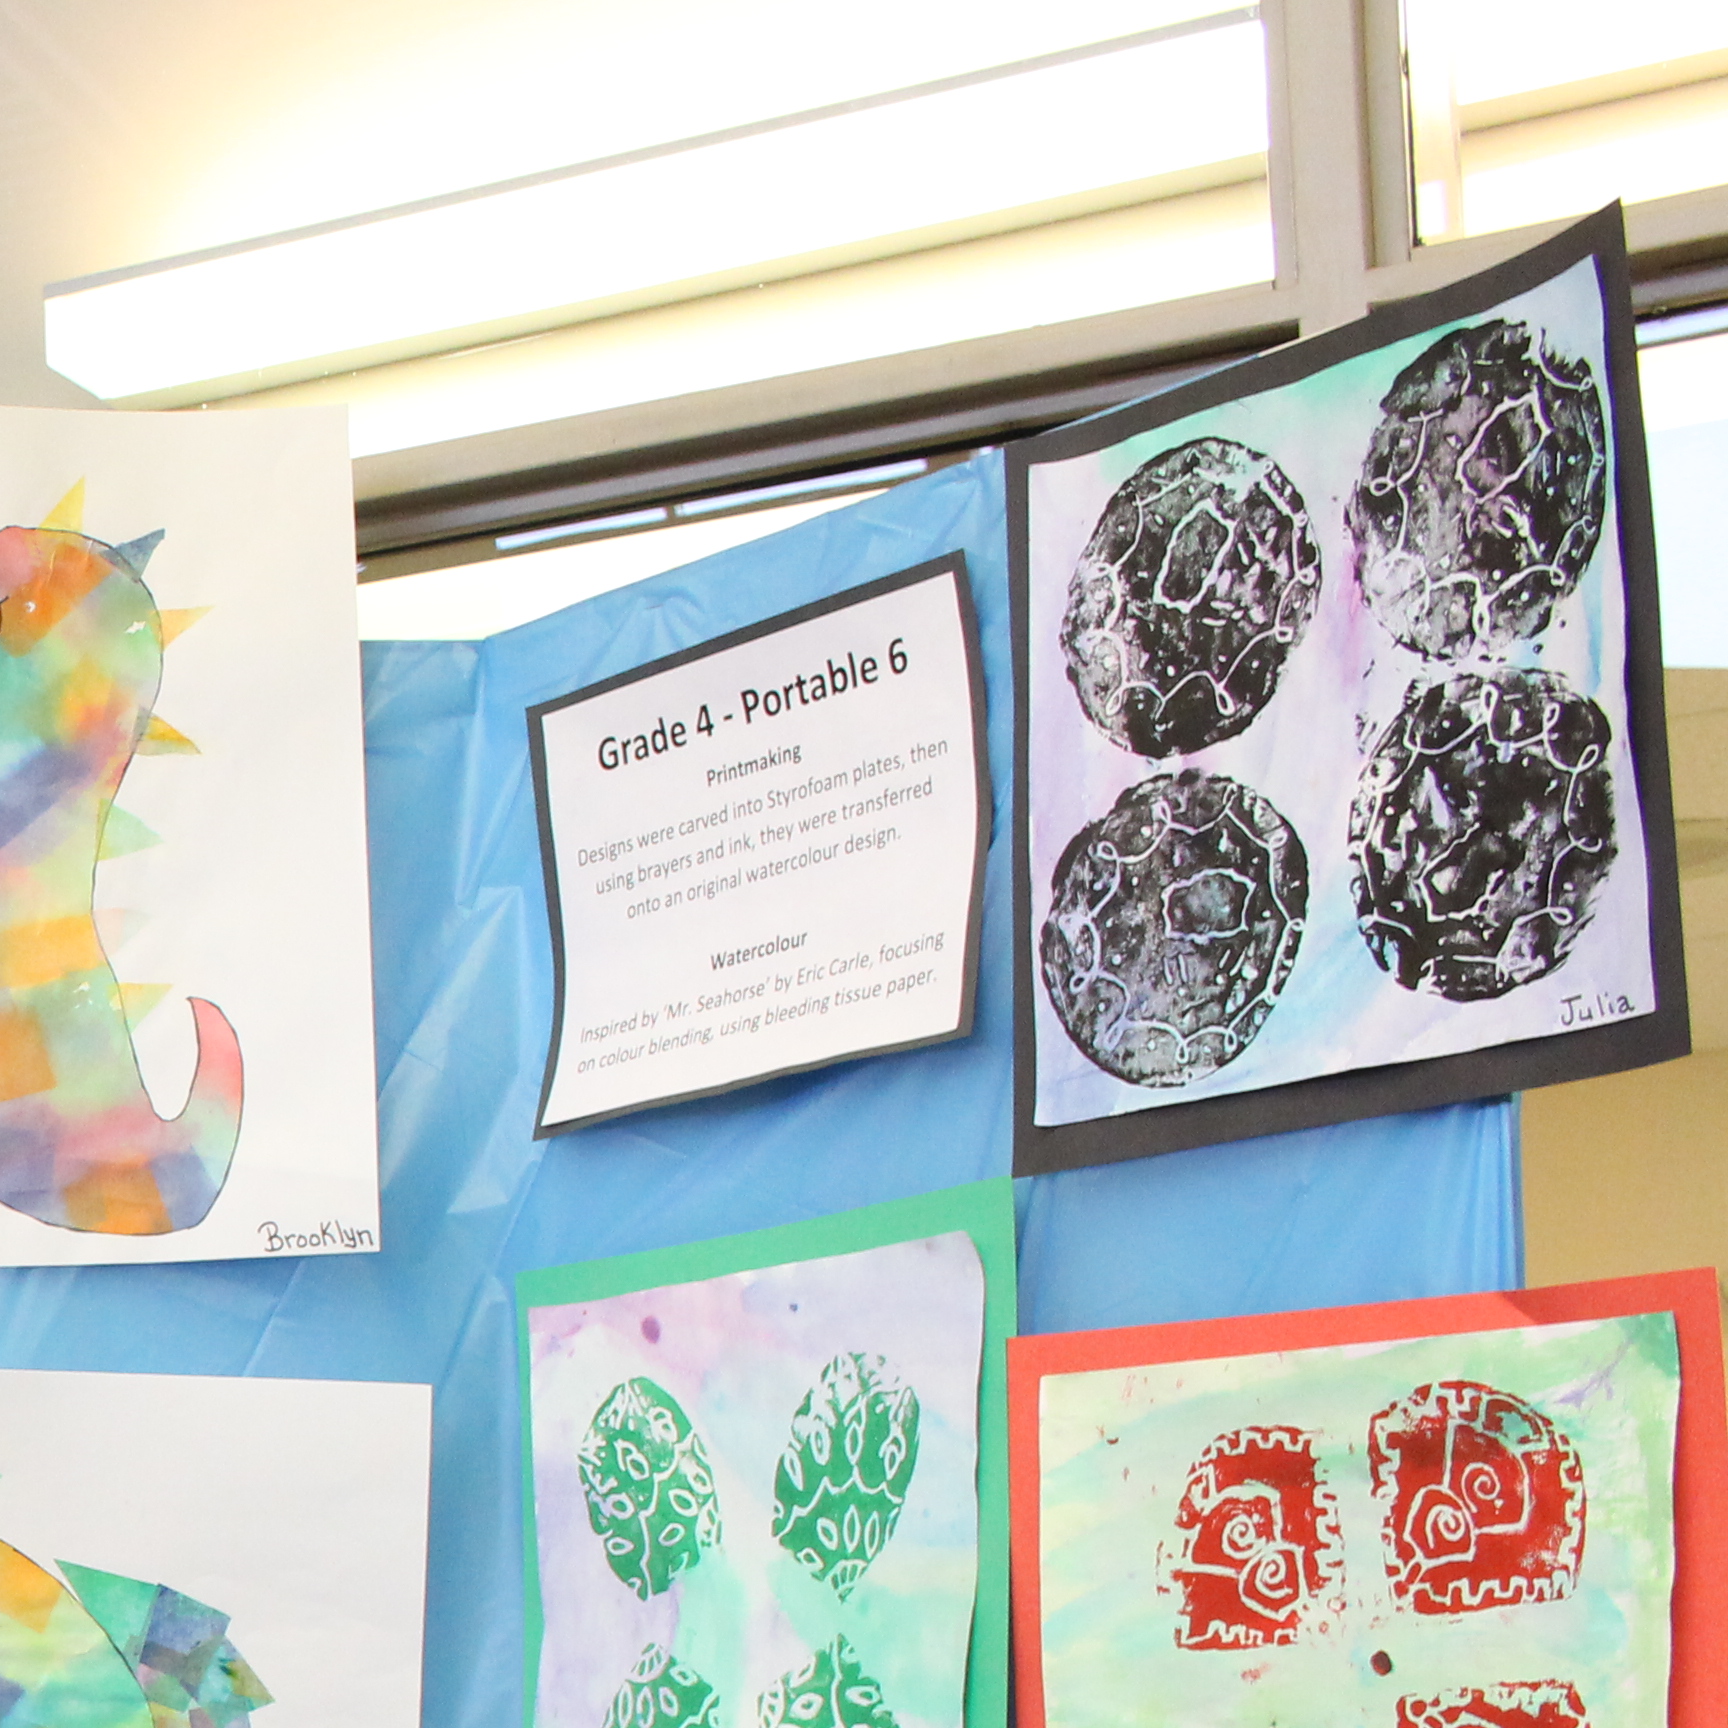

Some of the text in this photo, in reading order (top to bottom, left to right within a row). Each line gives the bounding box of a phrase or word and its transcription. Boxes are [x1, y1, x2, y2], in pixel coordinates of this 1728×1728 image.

[598, 638, 908, 771] Grade 4 - Portable 6
[578, 737, 949, 868] Designs were carved into Styrofoam plates, then
[707, 743, 802, 787] Printmaking
[596, 775, 933, 897] using brayers and ink, they were transferred
[627, 824, 901, 920] onto an original watercolour design.
[581, 930, 945, 1045] Inspired by 'Mr. Seahorse' by Eric Carle, focusing
[711, 930, 807, 972] Watercolour
[577, 967, 937, 1074] on colour blending, using bleeding tissue paper.
[1560, 993, 1635, 1026] Julia
